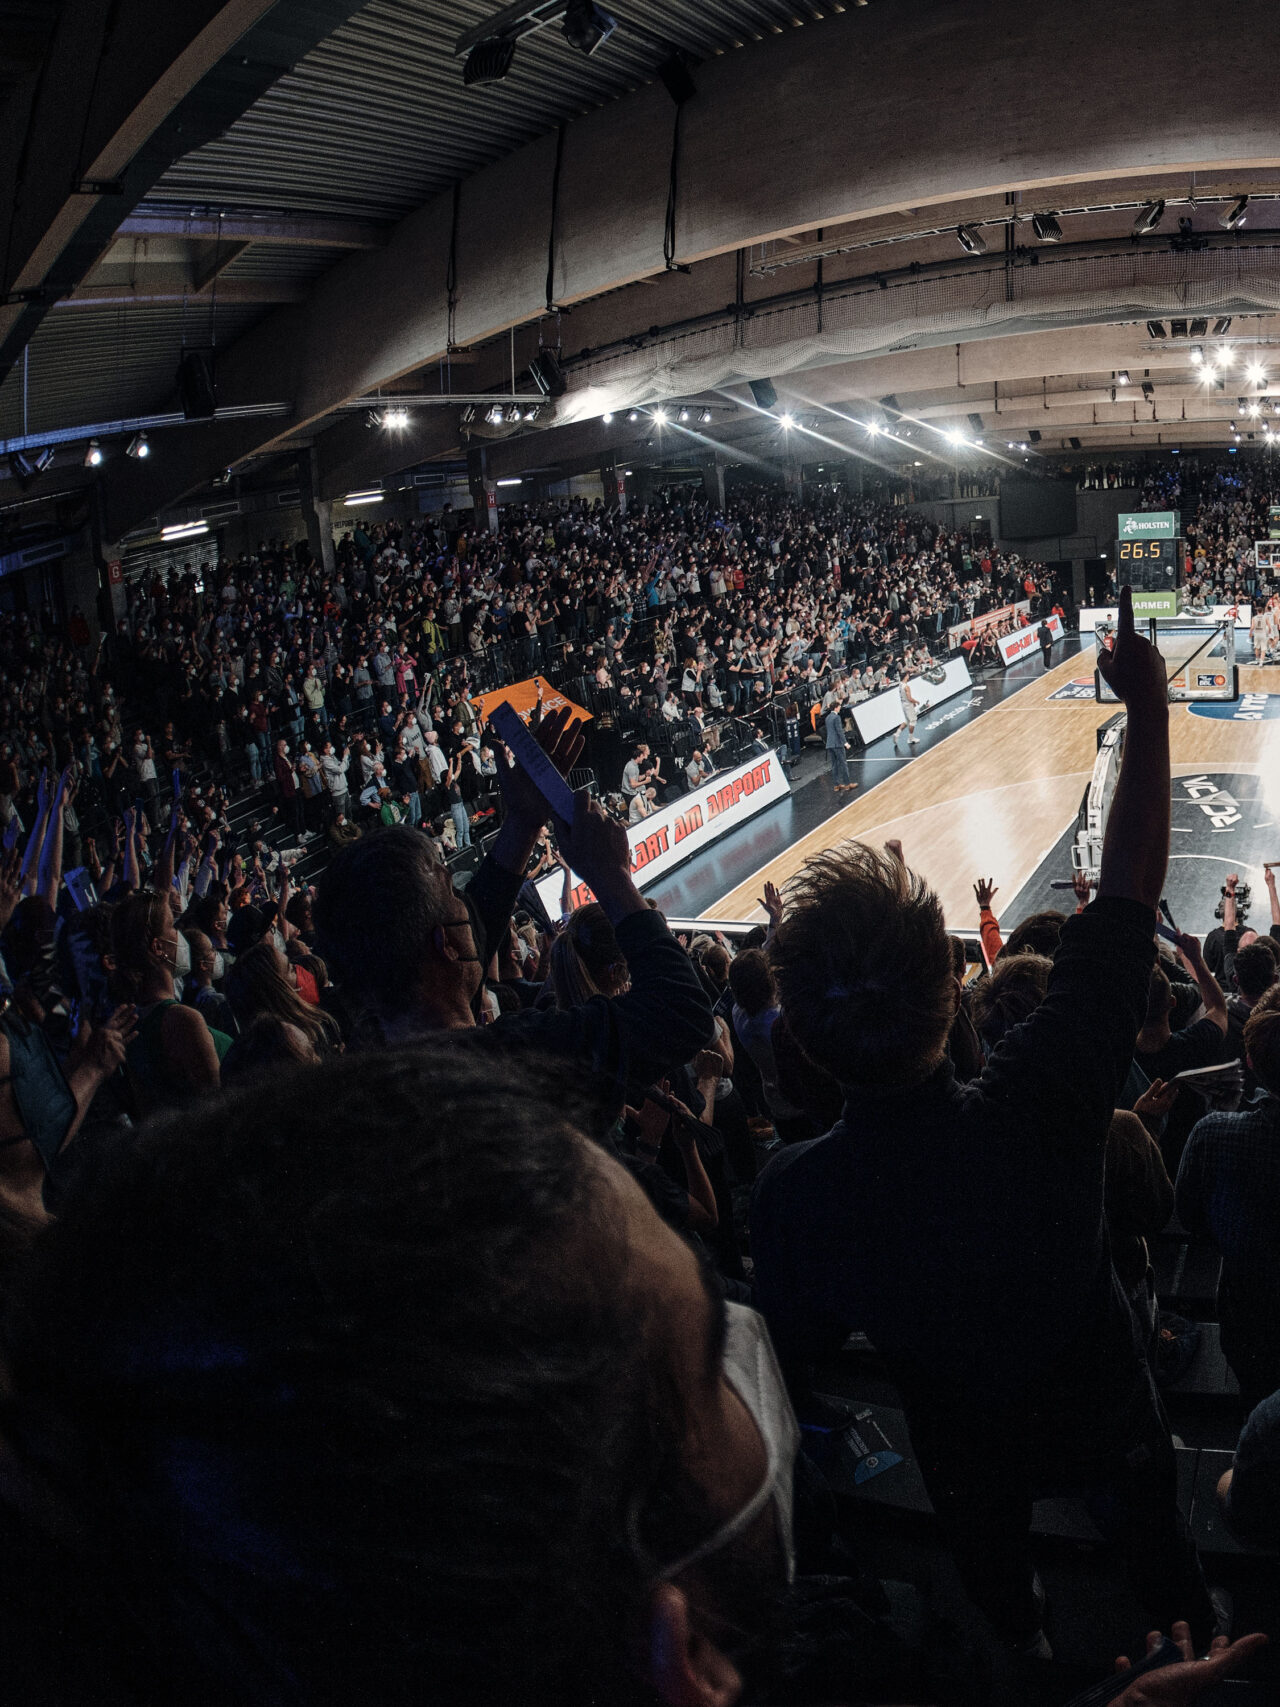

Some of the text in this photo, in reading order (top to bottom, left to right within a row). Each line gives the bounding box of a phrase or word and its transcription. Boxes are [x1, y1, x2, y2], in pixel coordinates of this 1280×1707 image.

[489, 495, 495, 504] H
[1138, 521, 1170, 530] HOLSTEN
[1120, 542, 1160, 559] 26.5
[112, 566, 120, 579] G
[1133, 601, 1170, 609] ARMER
[1238, 693, 1269, 711] VTG
[674, 804, 704, 845] AM
[707, 758, 771, 823] AIRPORT
